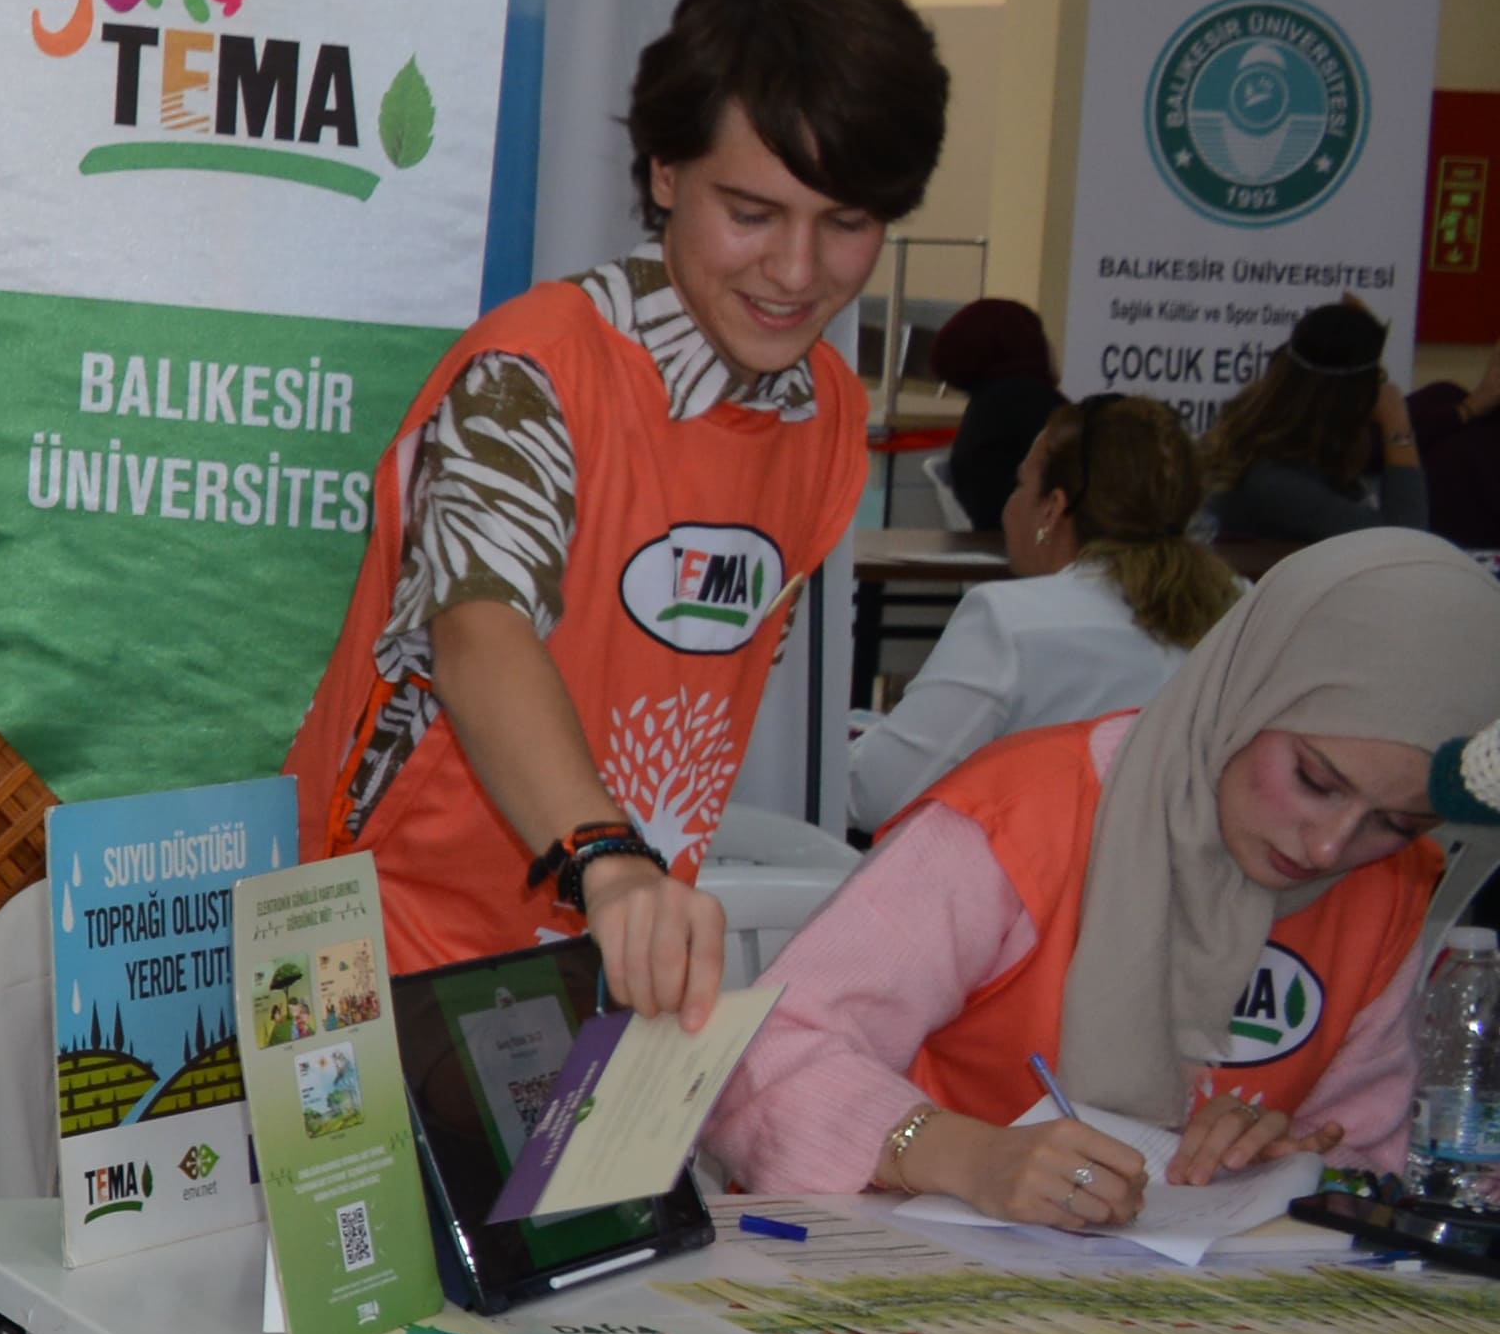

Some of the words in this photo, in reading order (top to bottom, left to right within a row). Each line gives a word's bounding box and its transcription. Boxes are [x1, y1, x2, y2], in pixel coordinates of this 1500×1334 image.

[102, 23, 360, 148] TEMA
[1166, 16, 1242, 129] BALIKESİR
[1248, 9, 1349, 139] ÜNİVERSİTESİ
[1224, 184, 1279, 209] 1992
[1098, 256, 1226, 282] BALIKESİR
[1232, 259, 1397, 290] ÜNİVERSİTESİ
[1109, 298, 1155, 326] Sağlık
[1157, 298, 1200, 321] Kültür
[1204, 307, 1222, 321] ve
[1225, 303, 1259, 327] Spor
[79, 350, 355, 436] BALIKESİR
[1100, 343, 1206, 389] ÇOCUK
[1213, 340, 1276, 386] EĞİT
[28, 432, 372, 534] ÜNİVERSİTES
[103, 841, 156, 889] SUYU
[159, 821, 248, 881] DÜŞTÜĞÜ
[84, 889, 167, 950] TOPRAĞI
[125, 953, 188, 1001] YERDE
[190, 945, 233, 990] TUT!
[84, 1161, 139, 1206] TEMA
